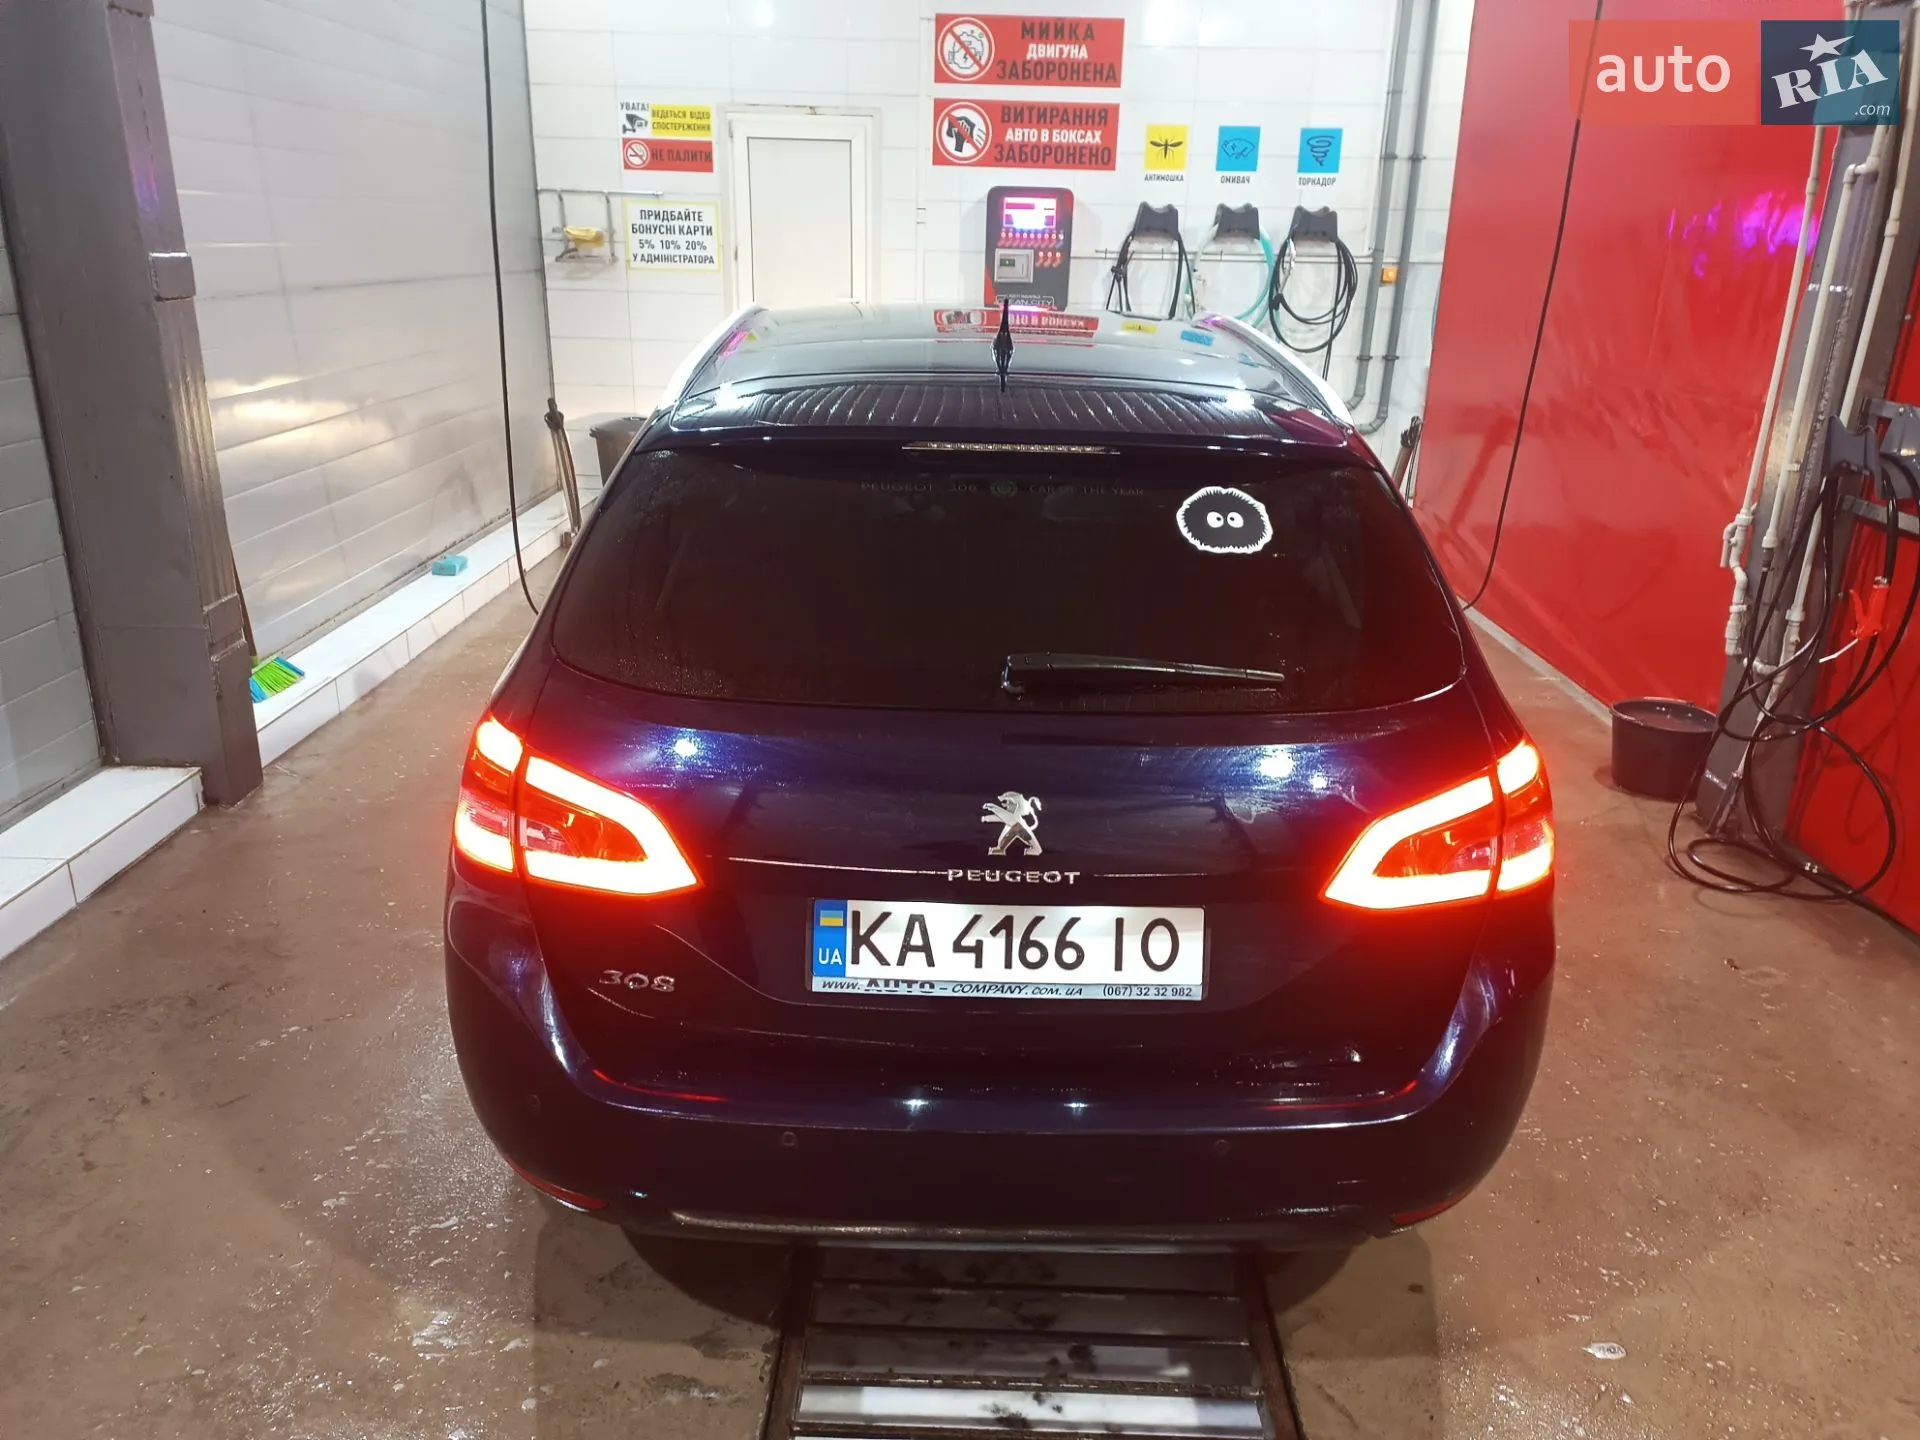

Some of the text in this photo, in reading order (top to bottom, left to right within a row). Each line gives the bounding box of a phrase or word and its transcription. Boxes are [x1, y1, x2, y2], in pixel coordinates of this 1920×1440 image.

[1021, 20, 1095, 41] МИЙКА
[1027, 43, 1088, 60] ДВИГУНА
[996, 59, 1117, 82] ЗАБОРОНЕНА
[620, 102, 650, 111] УВАГА!
[651, 110, 710, 120] ВЕДЕТЬСЯ ВІДЕО
[1001, 106, 1108, 126] ВИТИРАННЯ
[652, 121, 711, 132] СПОСТЕРЕЖЕННЯ
[1005, 128, 1102, 144] АВТО В БОКСАХ
[652, 149, 712, 164] НЕ ПАЛИТИ
[994, 144, 1112, 166] ЗАБОРОНЕНО
[1144, 173, 1184, 182] АНТИМОШКА
[1220, 175, 1250, 184] ОМИВАЧ
[1298, 177, 1336, 187] ТОРНАДОР
[640, 208, 703, 223] ПРИДБАЙТЕ
[631, 223, 713, 237] БОНУСНІ КАРТИ
[638, 238, 707, 252] 5% 10% 20%
[632, 252, 715, 265] У АДМІНІСТРАТОРА
[947, 868, 1081, 885] PEUGEOT
[850, 910, 1180, 972] KA 4166 IO
[818, 948, 843, 966] UA
[599, 969, 675, 992] 308
[1103, 986, 1132, 997] (067)
[1136, 987, 1151, 997] 32
[1154, 987, 1169, 997] 32
[1171, 987, 1193, 998] 982
